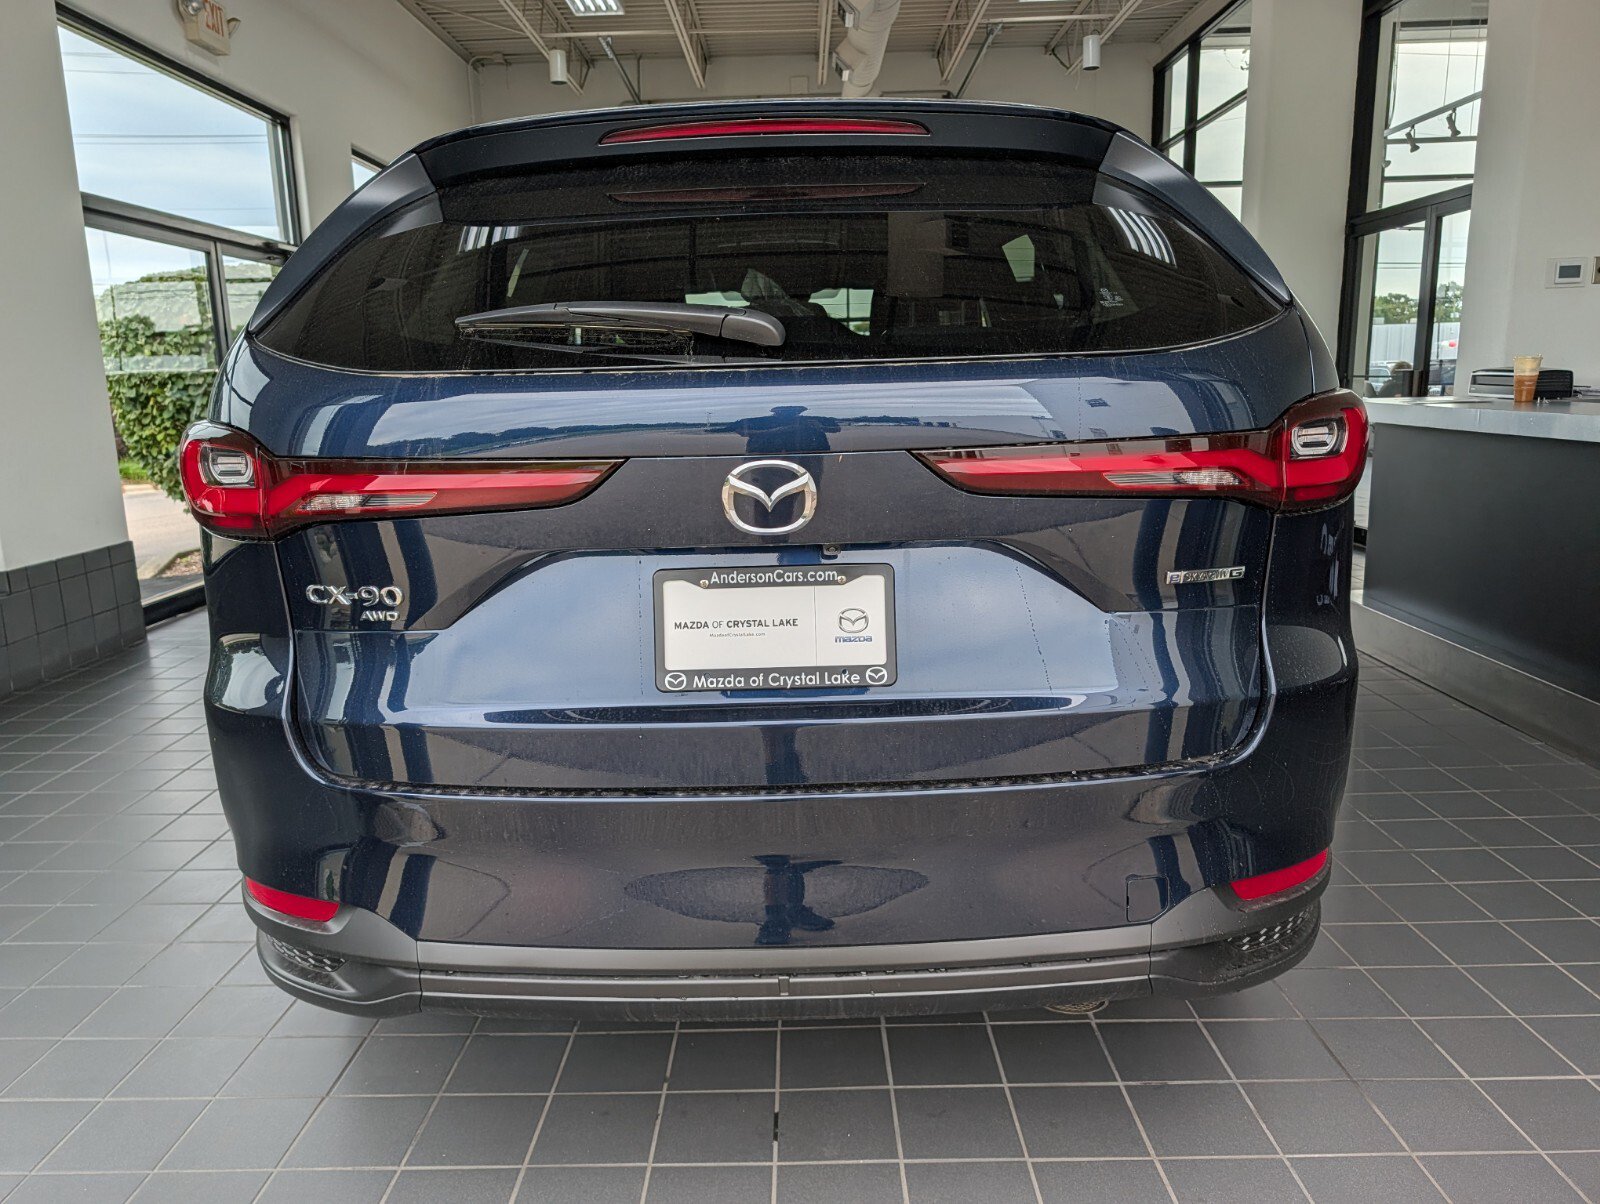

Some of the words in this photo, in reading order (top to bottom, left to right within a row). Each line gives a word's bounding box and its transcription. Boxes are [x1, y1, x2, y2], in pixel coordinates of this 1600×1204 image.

[203, 0, 224, 37] EXIT
[710, 570, 838, 585] AndersonCars.com
[305, 584, 404, 607] CX-90
[360, 610, 400, 622] AWD
[674, 621, 709, 630] MAZDA
[712, 620, 724, 629] OF
[726, 619, 770, 628] CRYSTAL
[772, 618, 798, 627] LAKE
[693, 673, 745, 688] Mazda
[750, 673, 763, 686] of
[768, 672, 820, 689] Crystal
[824, 671, 860, 685] Lake
